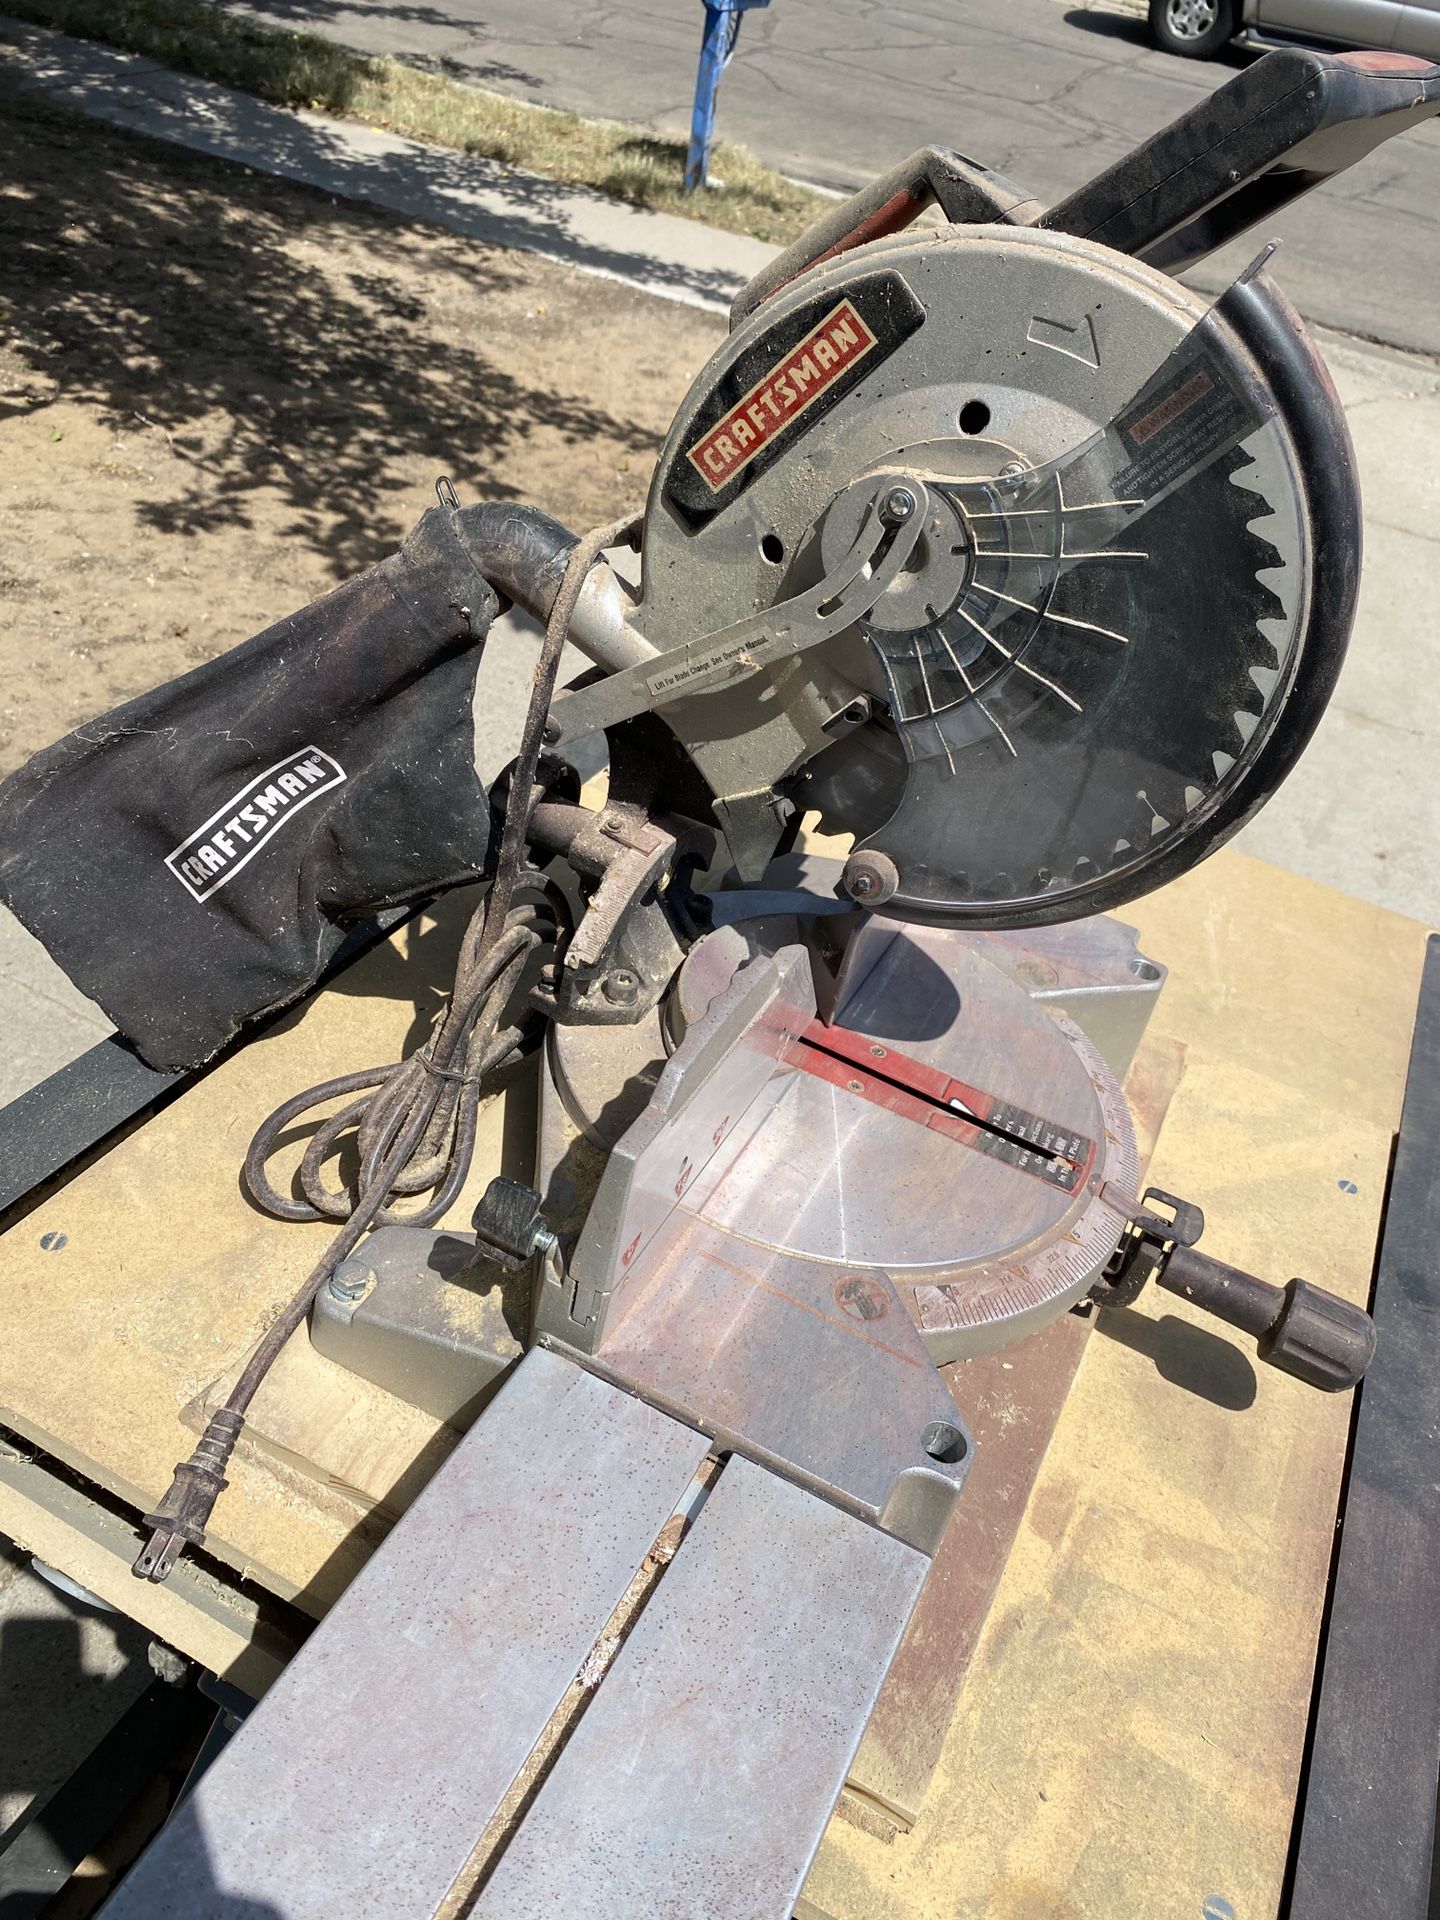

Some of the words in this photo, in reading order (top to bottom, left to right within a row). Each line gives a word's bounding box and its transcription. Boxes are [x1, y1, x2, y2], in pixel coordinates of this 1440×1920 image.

[1123, 481, 1138, 496] AND
[674, 671, 690, 682] Blade
[711, 656, 723, 666] See
